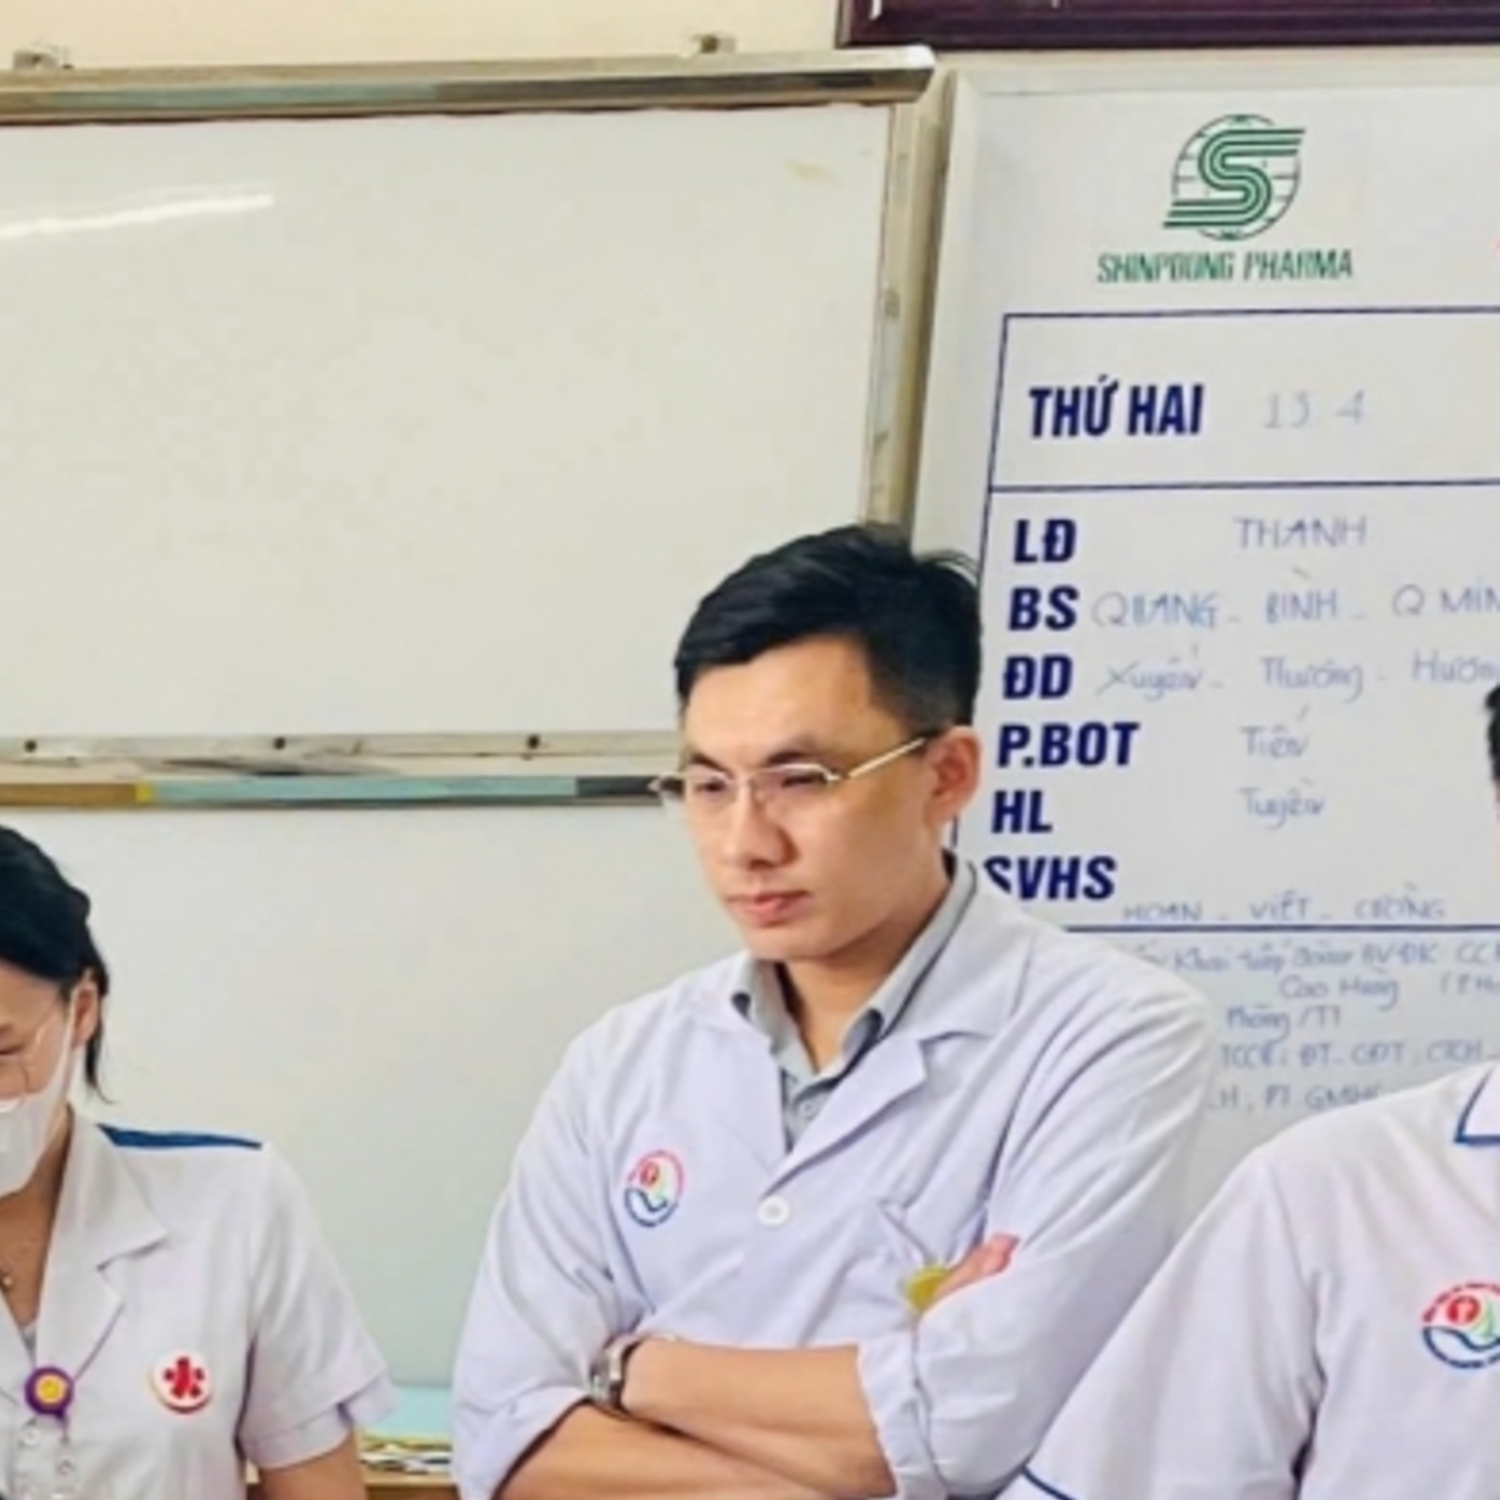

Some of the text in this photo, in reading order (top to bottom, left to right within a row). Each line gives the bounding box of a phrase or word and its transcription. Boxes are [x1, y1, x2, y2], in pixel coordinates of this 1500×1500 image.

[1097, 248, 1353, 284] SHINPOONG PHARMA
[1029, 374, 1204, 439] THỨ HAI
[1013, 518, 1077, 564] LĐ
[1007, 585, 1080, 631] BS
[1002, 654, 1075, 700] ĐD
[996, 722, 1140, 768] P.BOT
[990, 790, 1053, 834] HL
[984, 855, 1117, 902] SVHS
